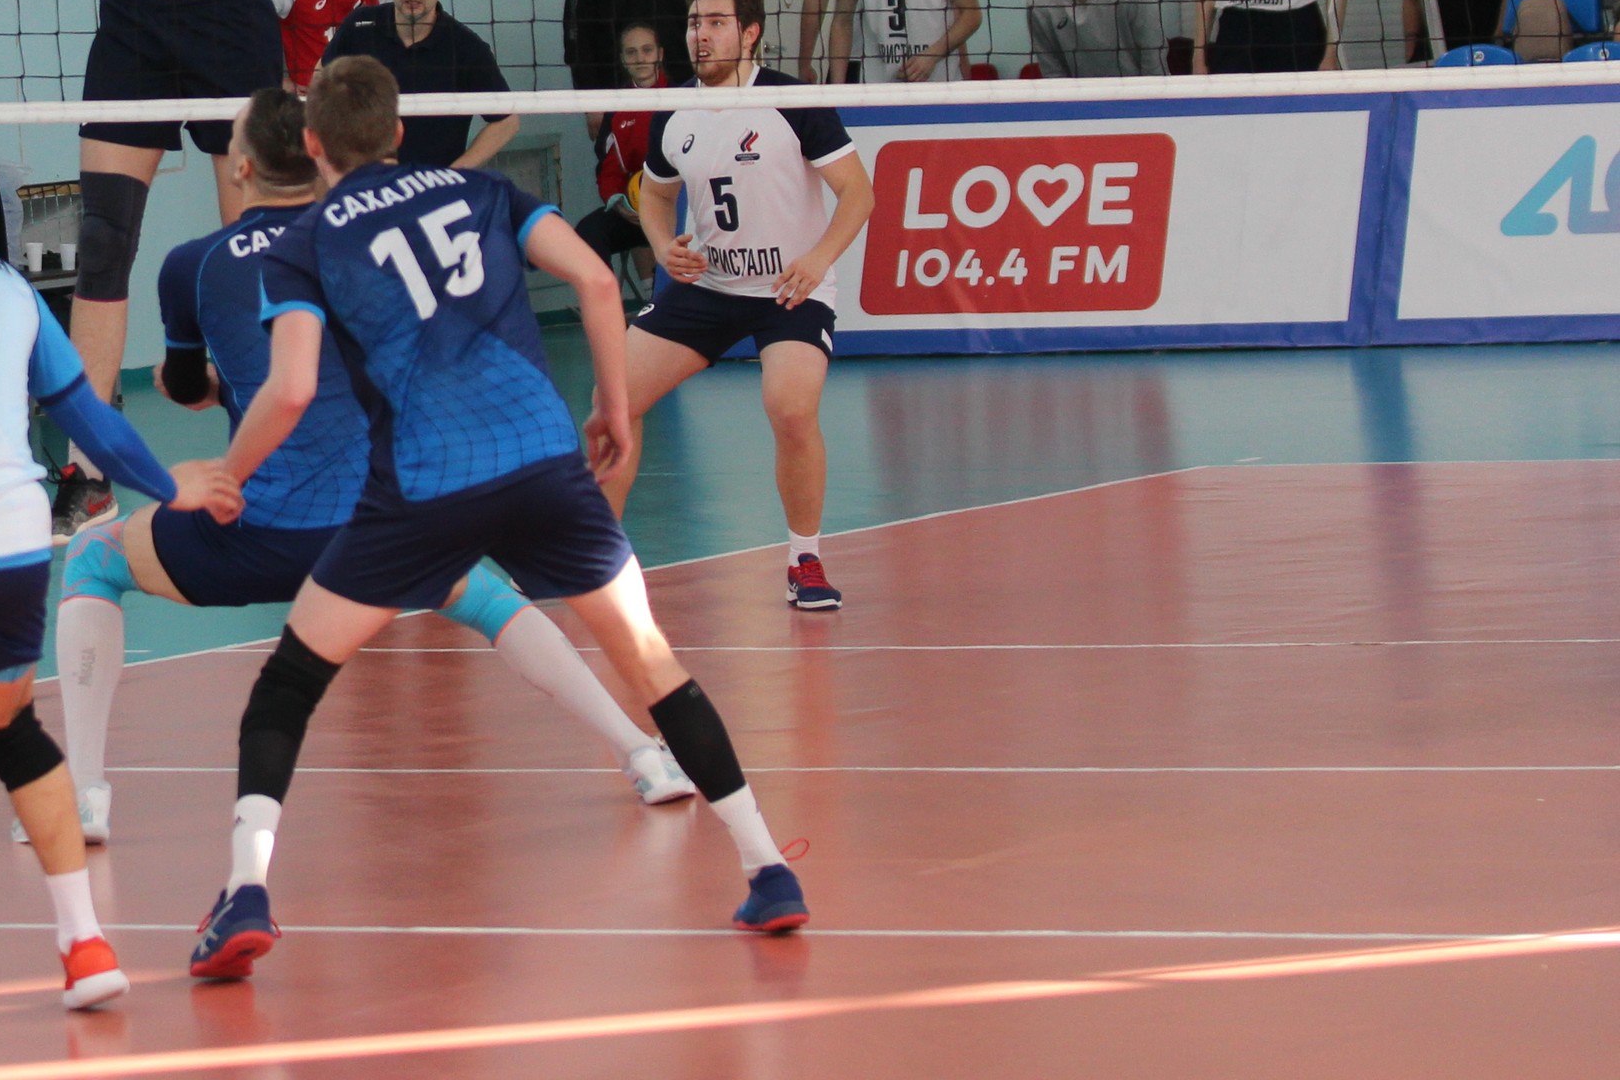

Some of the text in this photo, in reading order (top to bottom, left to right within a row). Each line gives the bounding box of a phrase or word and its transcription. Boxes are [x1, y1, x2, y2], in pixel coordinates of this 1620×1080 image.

[324, 168, 468, 228] САХАЛИН
[708, 176, 740, 232] 5
[369, 198, 485, 321] 15
[896, 245, 1130, 288] 104.4 FM
